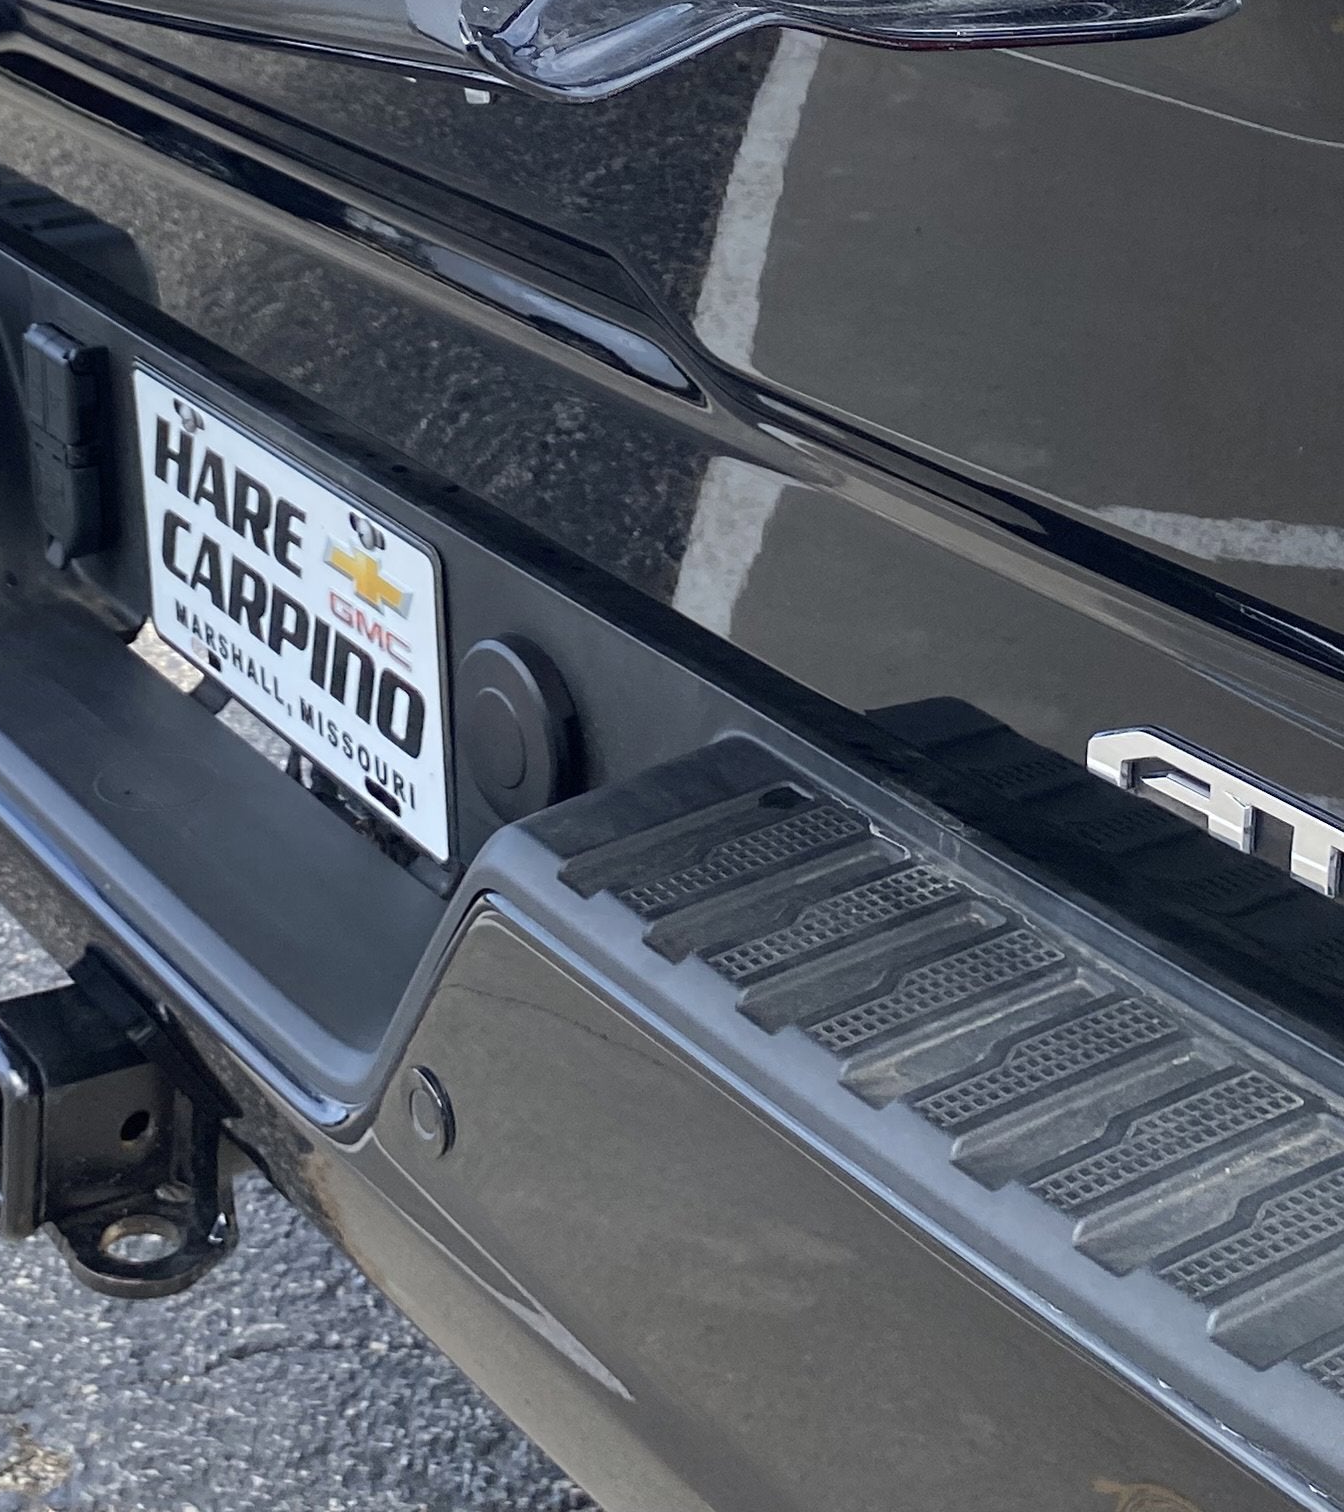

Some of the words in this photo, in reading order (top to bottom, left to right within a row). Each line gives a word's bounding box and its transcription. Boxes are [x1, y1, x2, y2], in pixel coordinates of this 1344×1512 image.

[155, 414, 306, 578] HARE
[162, 510, 425, 759] CARPINO
[175, 600, 294, 718] MARSHALL,
[299, 698, 416, 810] MISSOURI
[330, 590, 413, 673] GMC
